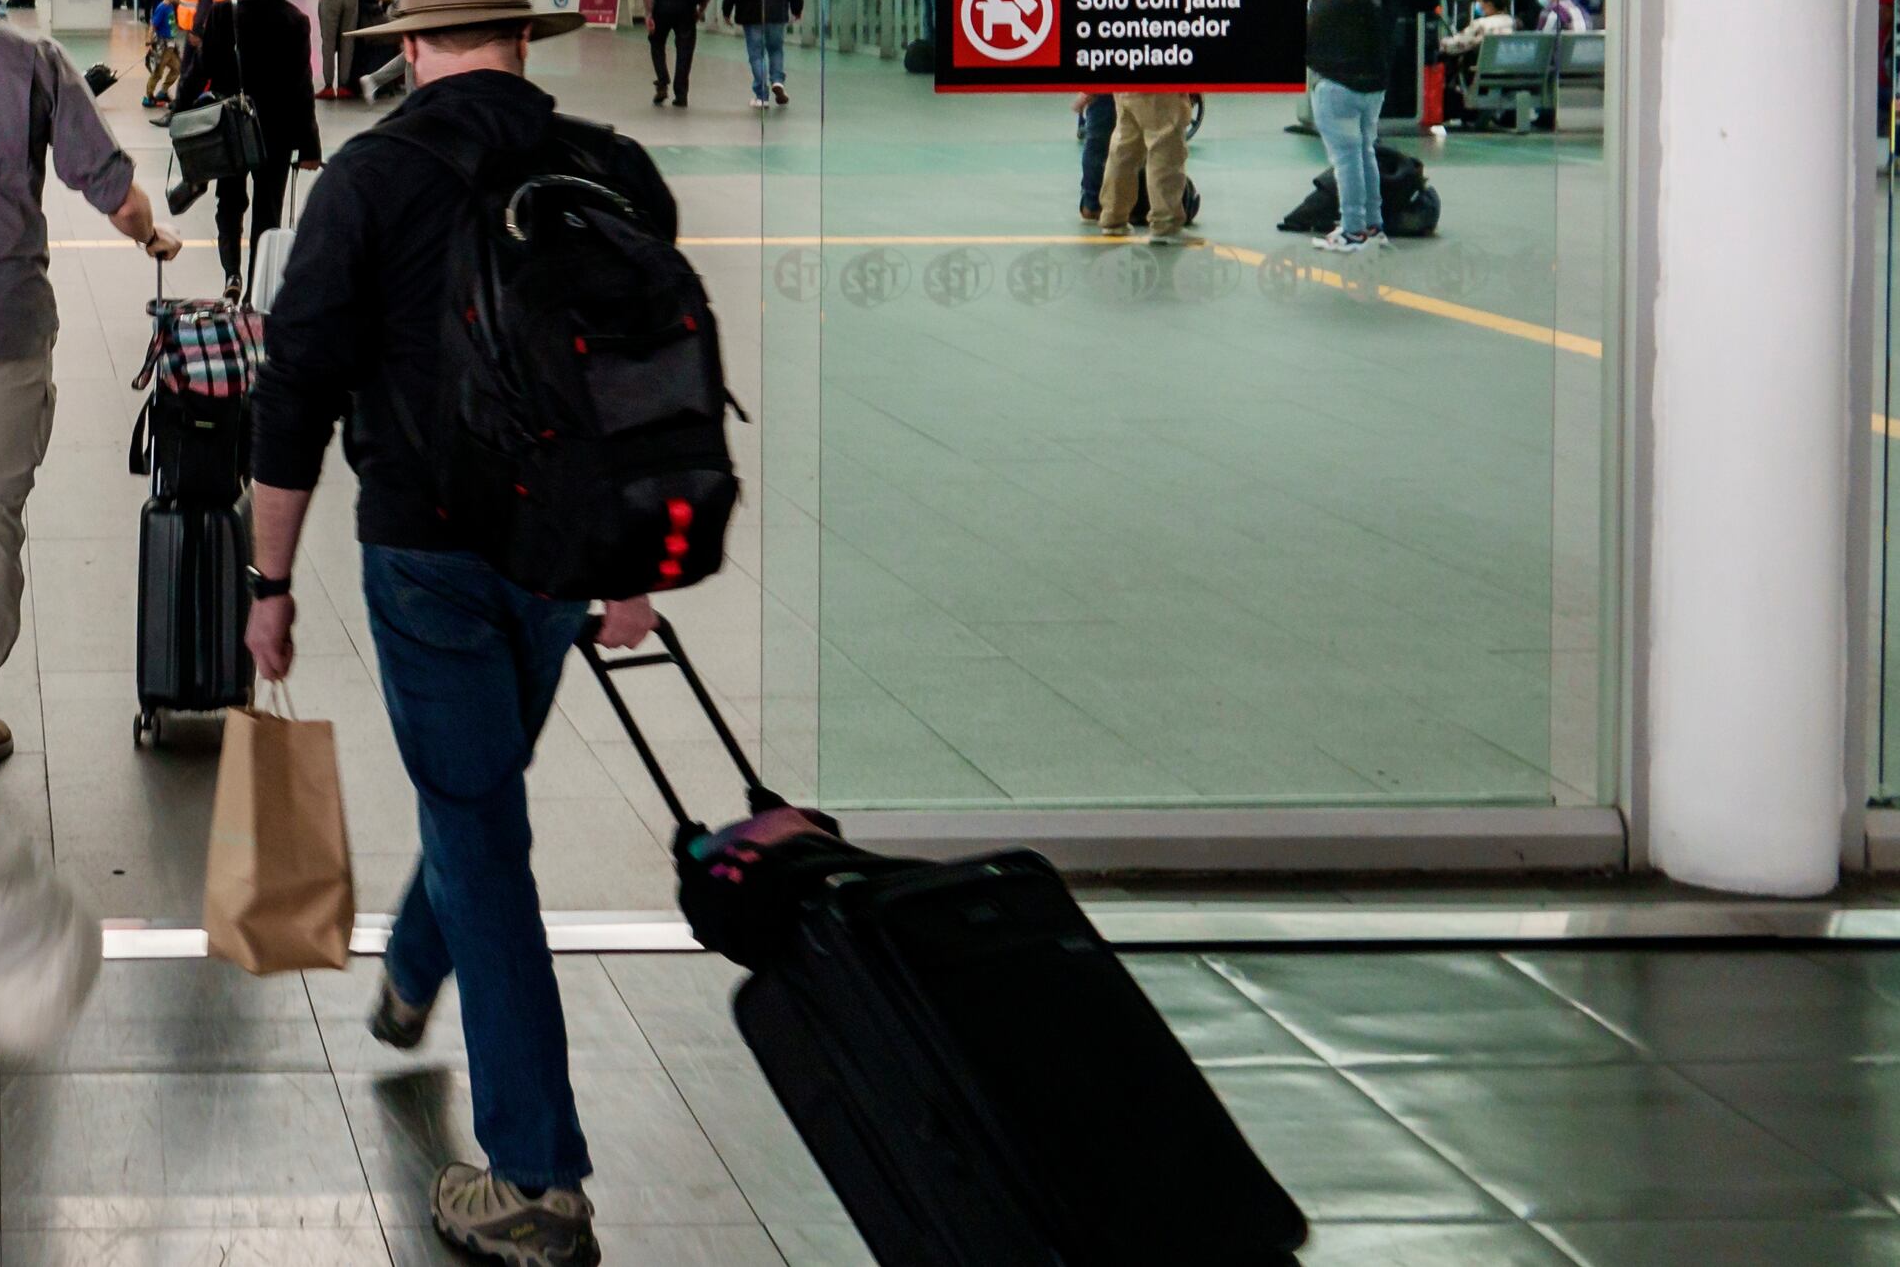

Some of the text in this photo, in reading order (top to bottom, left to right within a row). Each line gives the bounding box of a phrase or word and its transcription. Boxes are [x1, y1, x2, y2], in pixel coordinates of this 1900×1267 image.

[1076, 15, 1231, 39] o contenedor
[1076, 43, 1194, 72] apropiado
